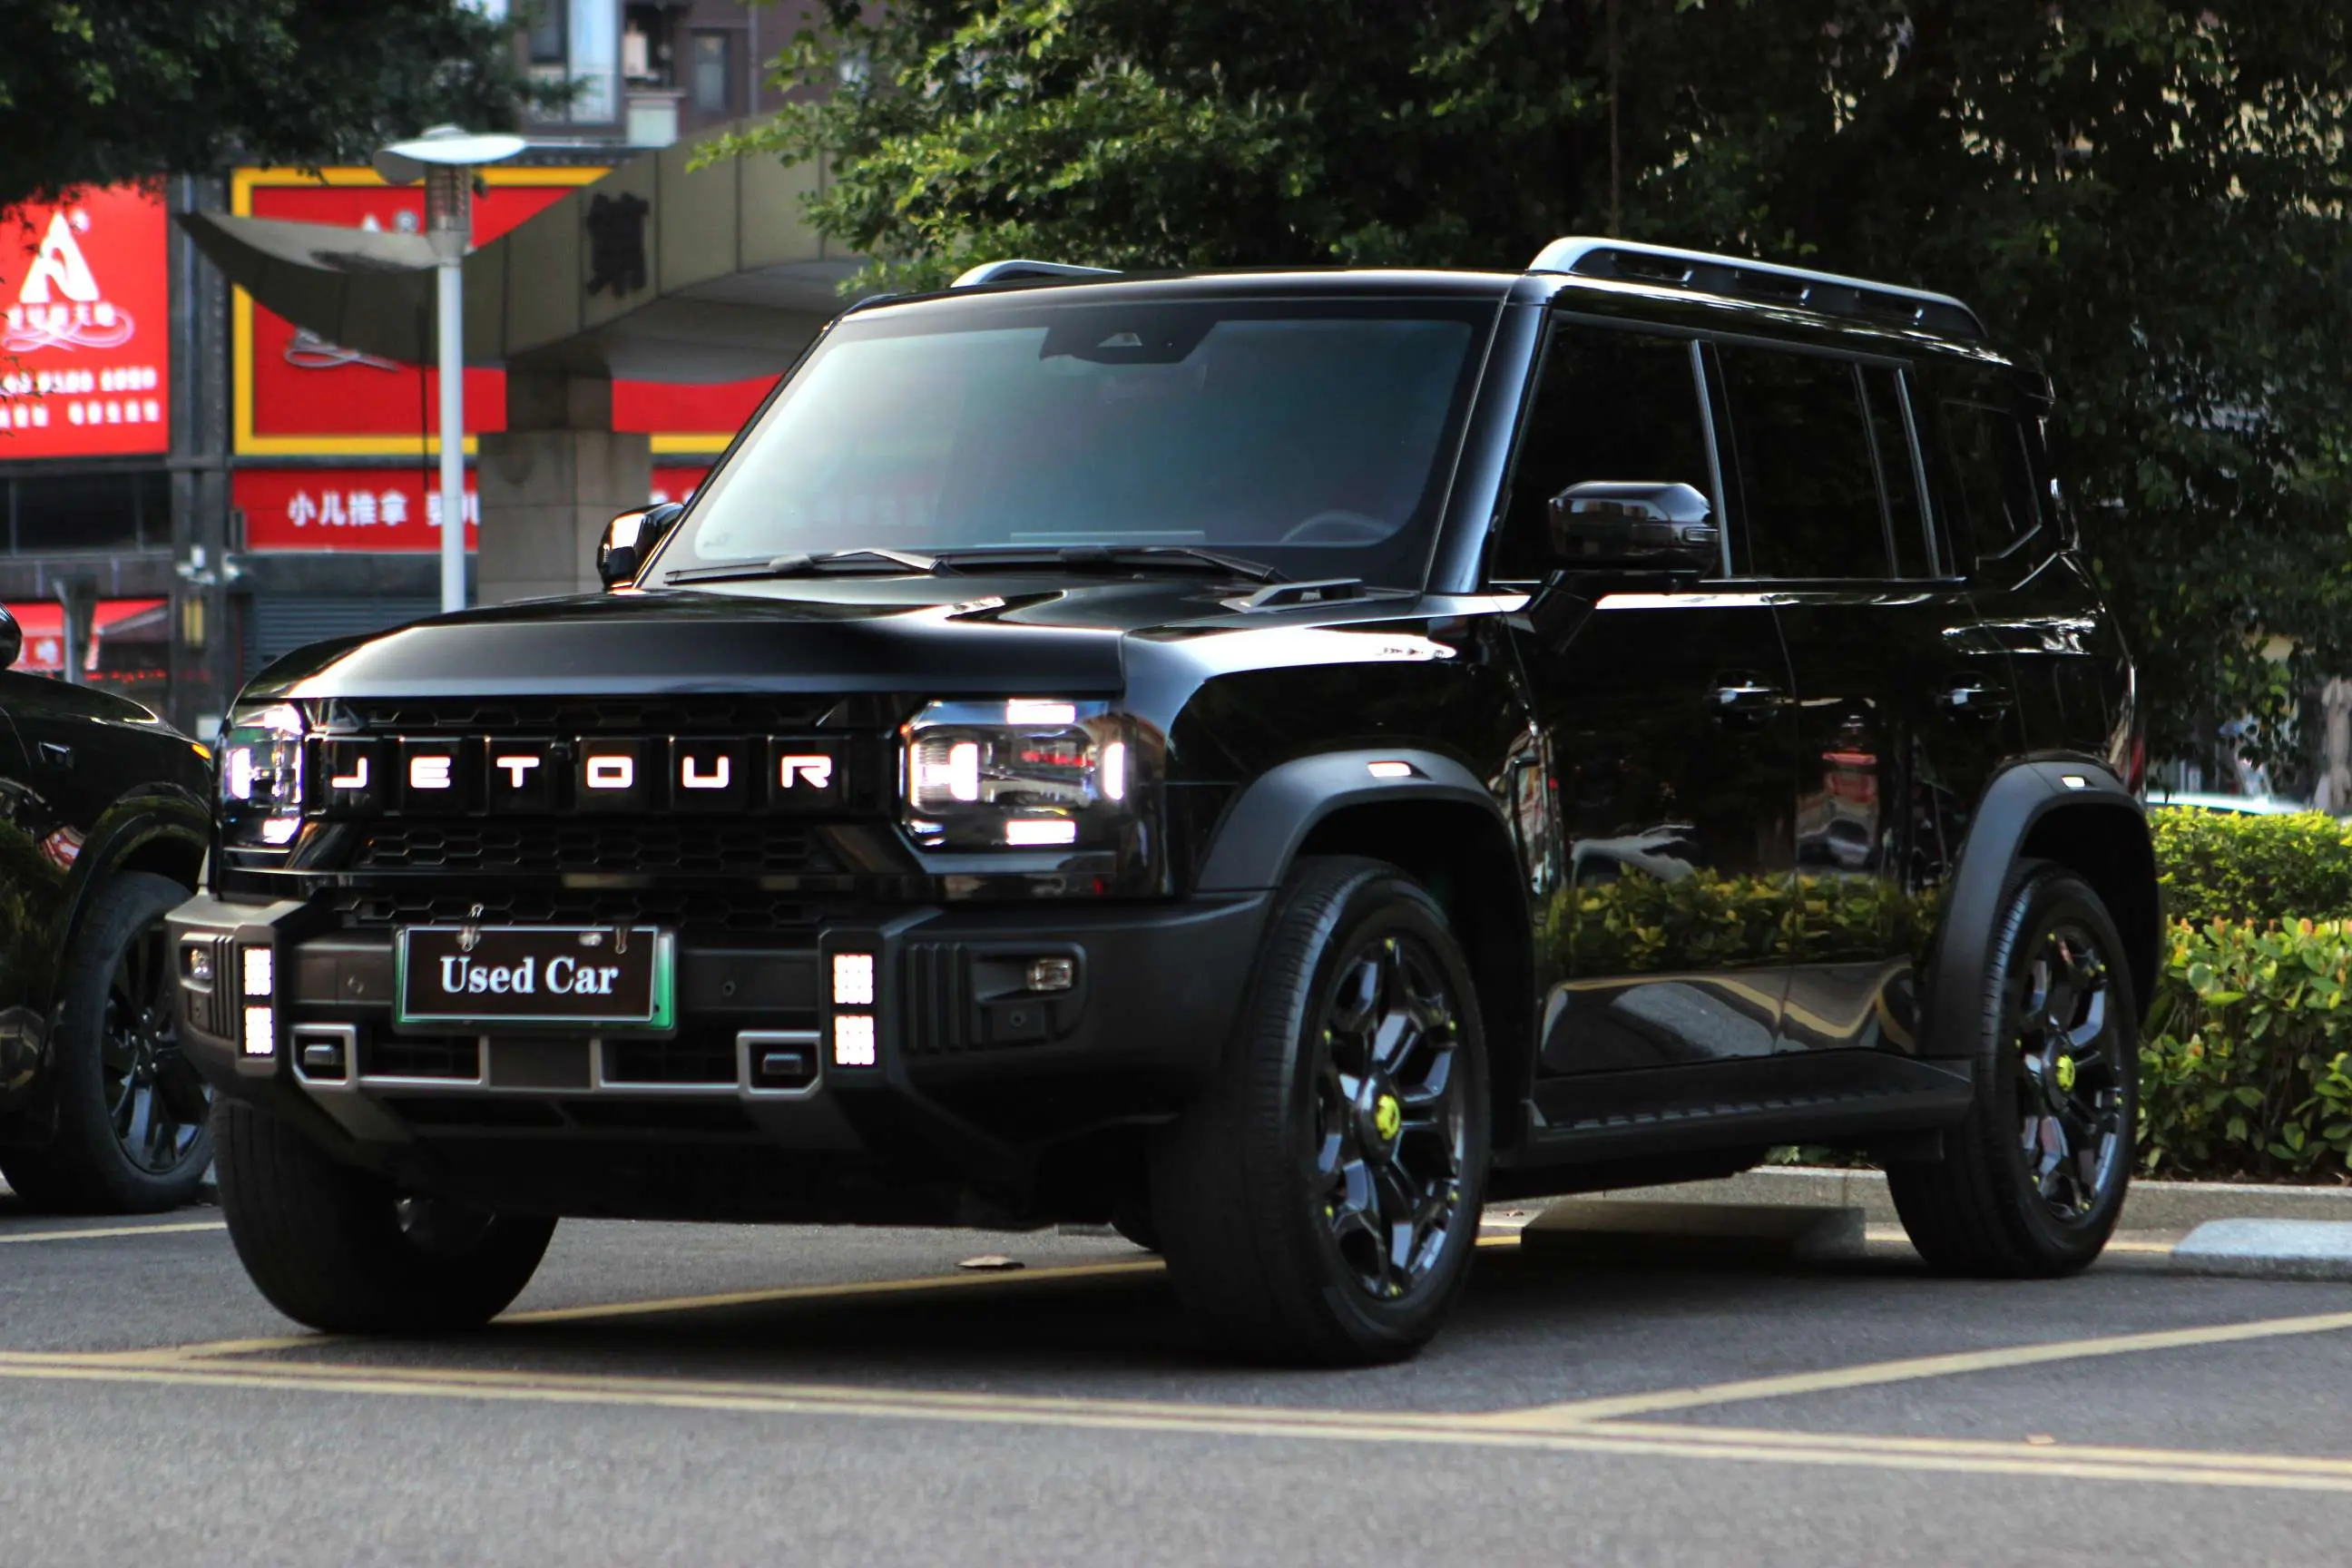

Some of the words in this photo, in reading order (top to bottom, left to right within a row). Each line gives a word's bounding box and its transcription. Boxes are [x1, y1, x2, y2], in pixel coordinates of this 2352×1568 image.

[288, 489, 408, 527] 小儿推拿
[331, 755, 832, 789] JETOUR
[439, 956, 536, 995] Used
[544, 956, 620, 995] Car
